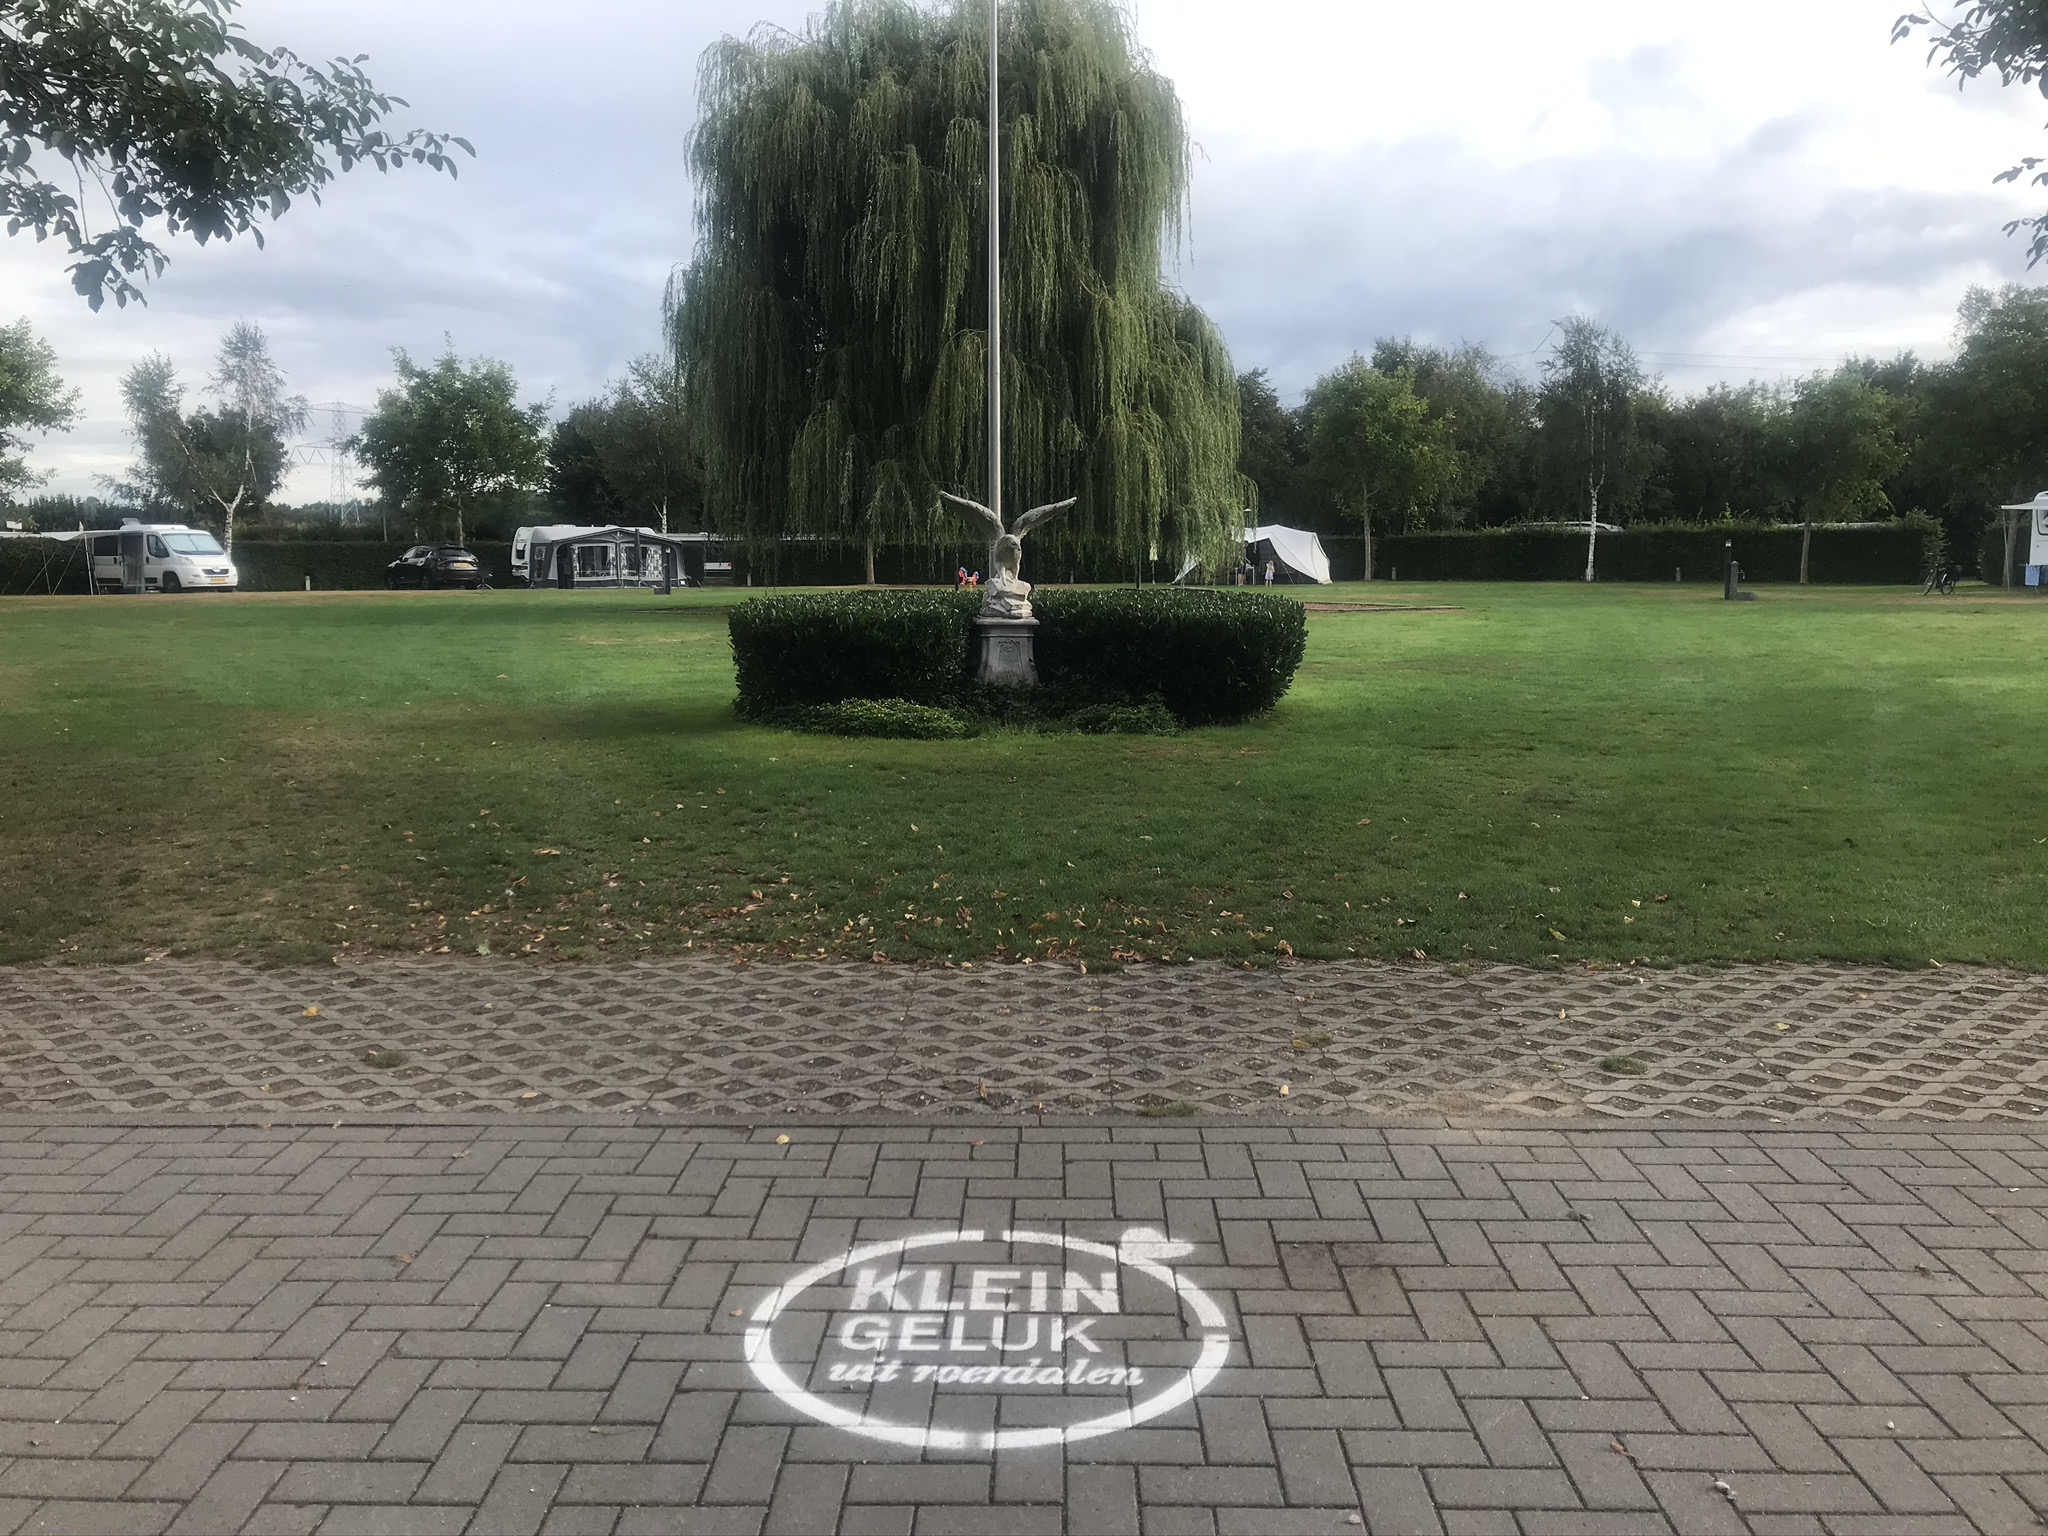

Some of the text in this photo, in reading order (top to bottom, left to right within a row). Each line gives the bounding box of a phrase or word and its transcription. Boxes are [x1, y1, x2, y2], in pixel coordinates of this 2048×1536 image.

[849, 1268, 1121, 1313] KLEIN
[841, 1315, 1102, 1352] GELUK
[828, 1358, 1145, 1386] uit roerdalen
